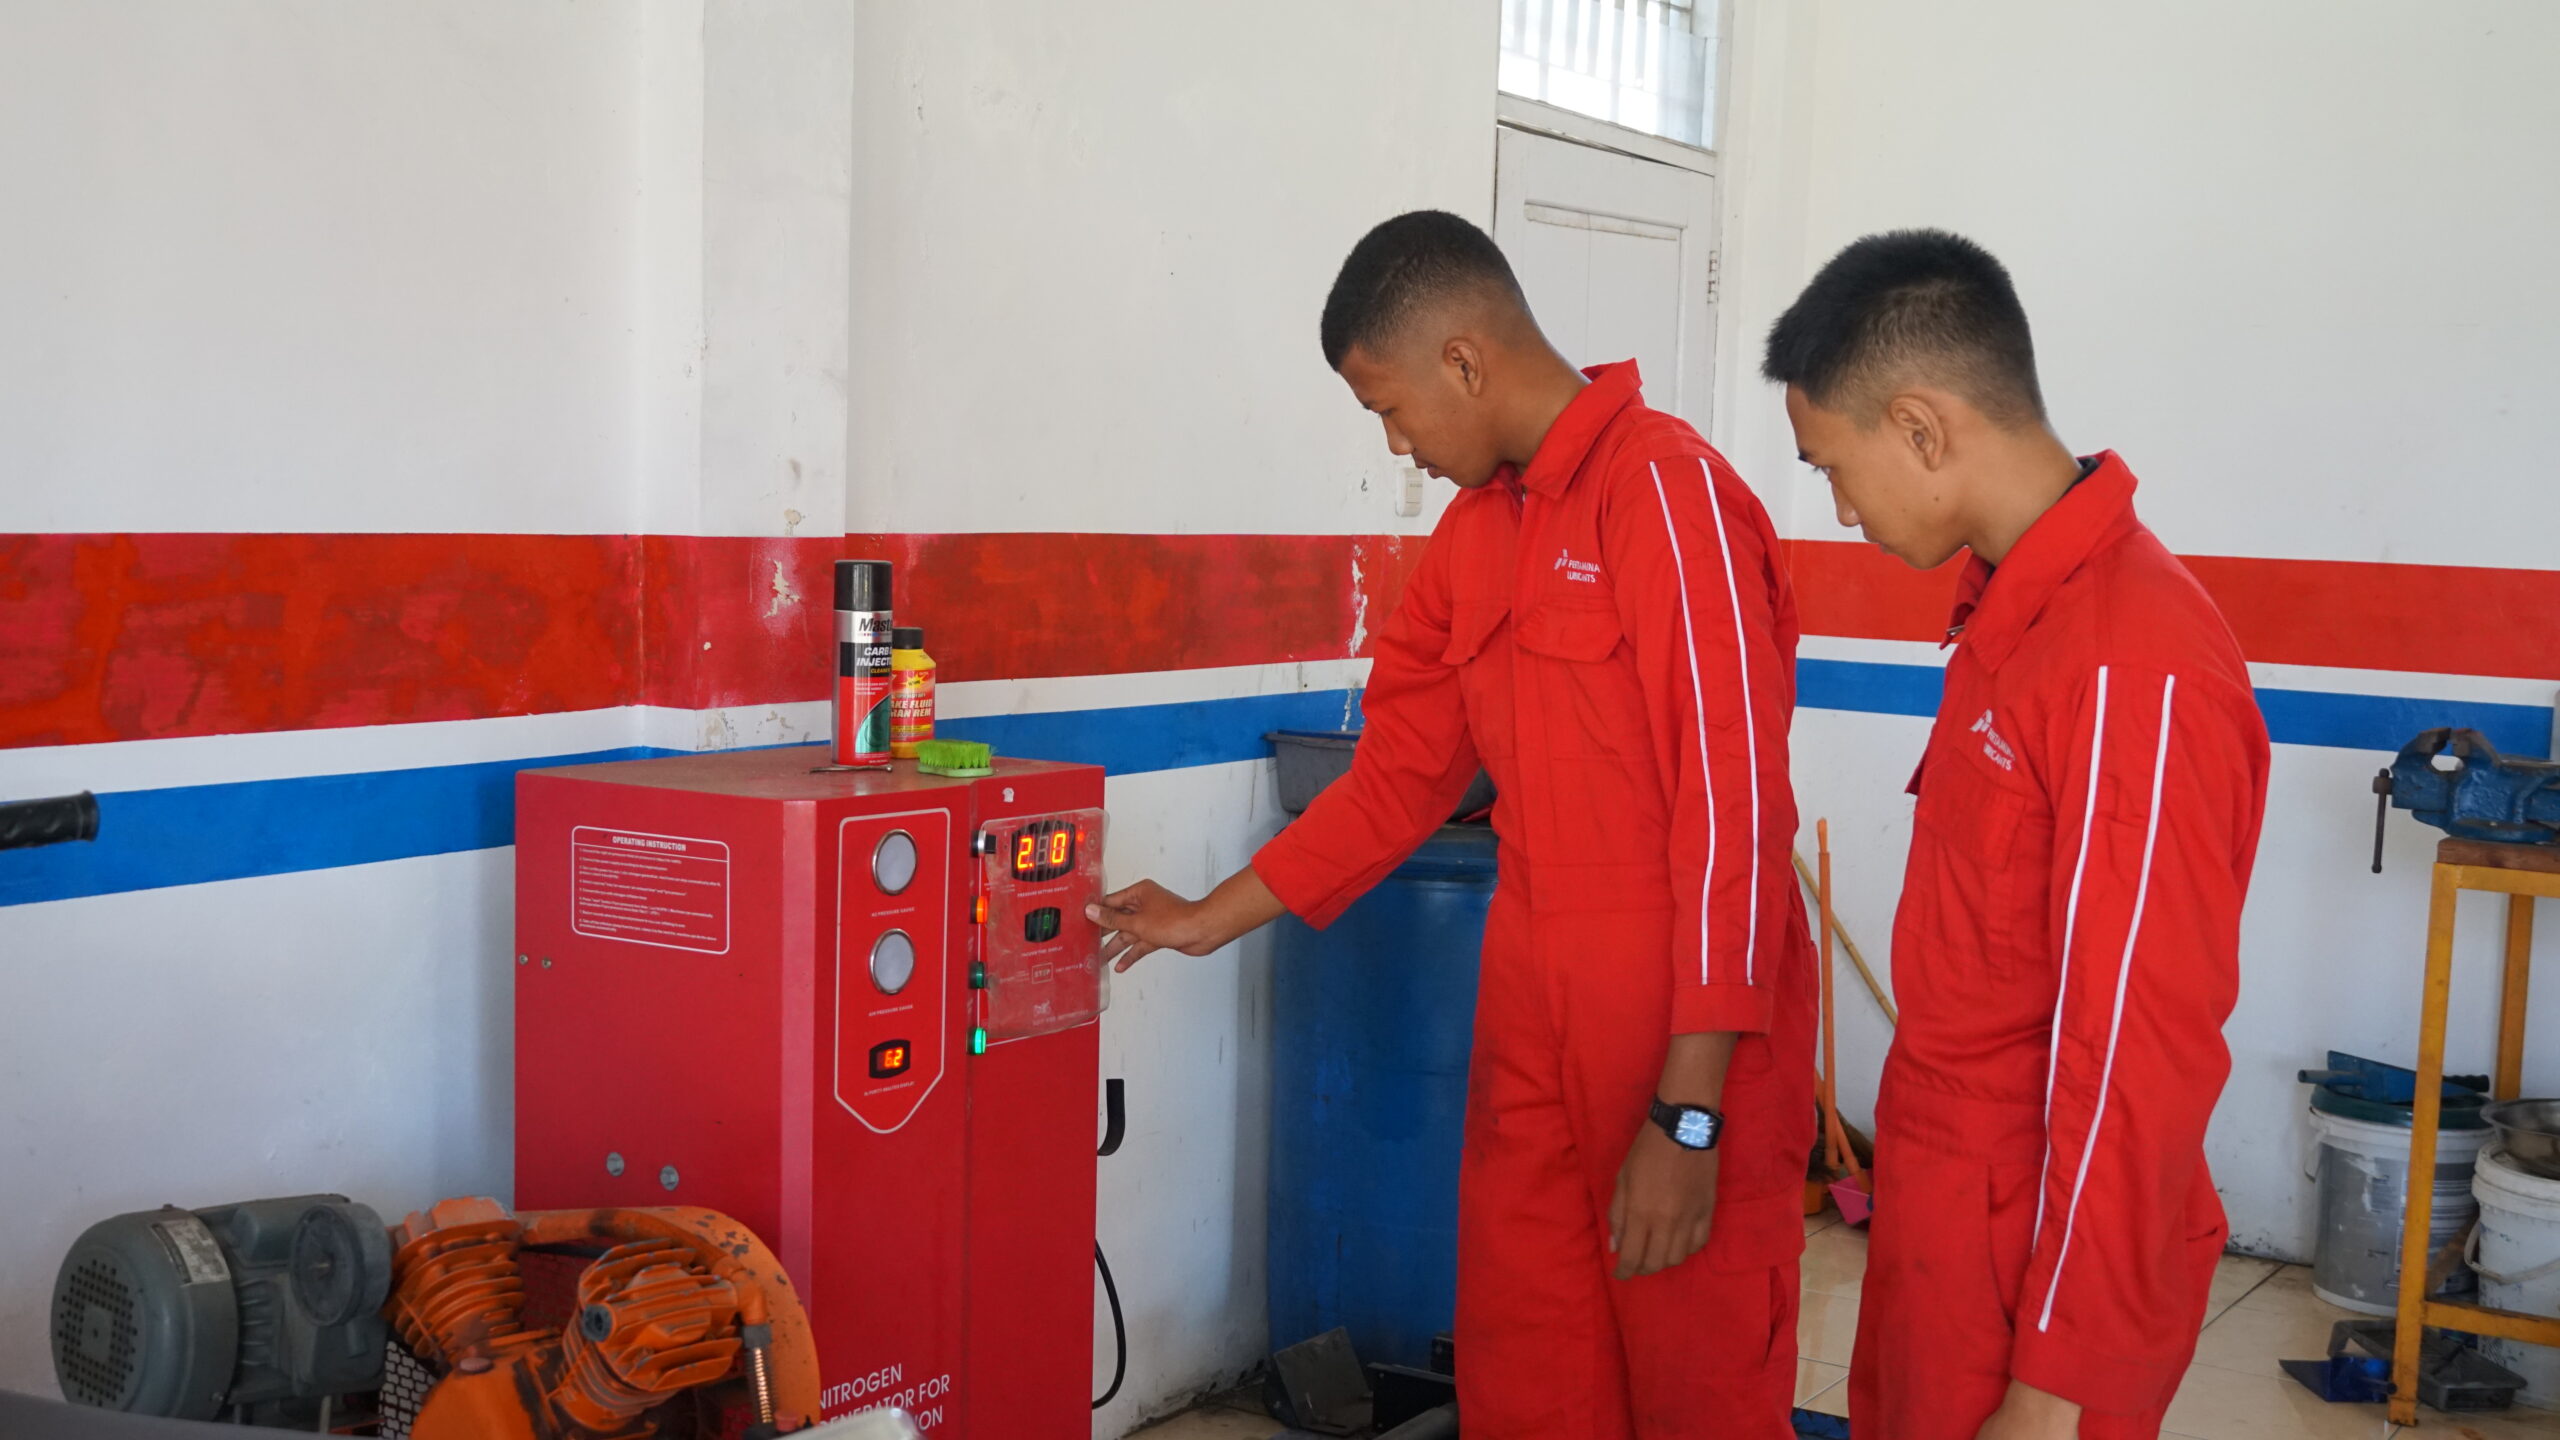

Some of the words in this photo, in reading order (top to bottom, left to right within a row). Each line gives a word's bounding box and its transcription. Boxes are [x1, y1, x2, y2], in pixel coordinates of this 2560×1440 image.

[612, 836, 646, 847] OPERATING
[646, 840, 687, 852] INSTRUCTION
[820, 1363, 902, 1410] NITROGEN
[919, 1374, 950, 1403] FOR
